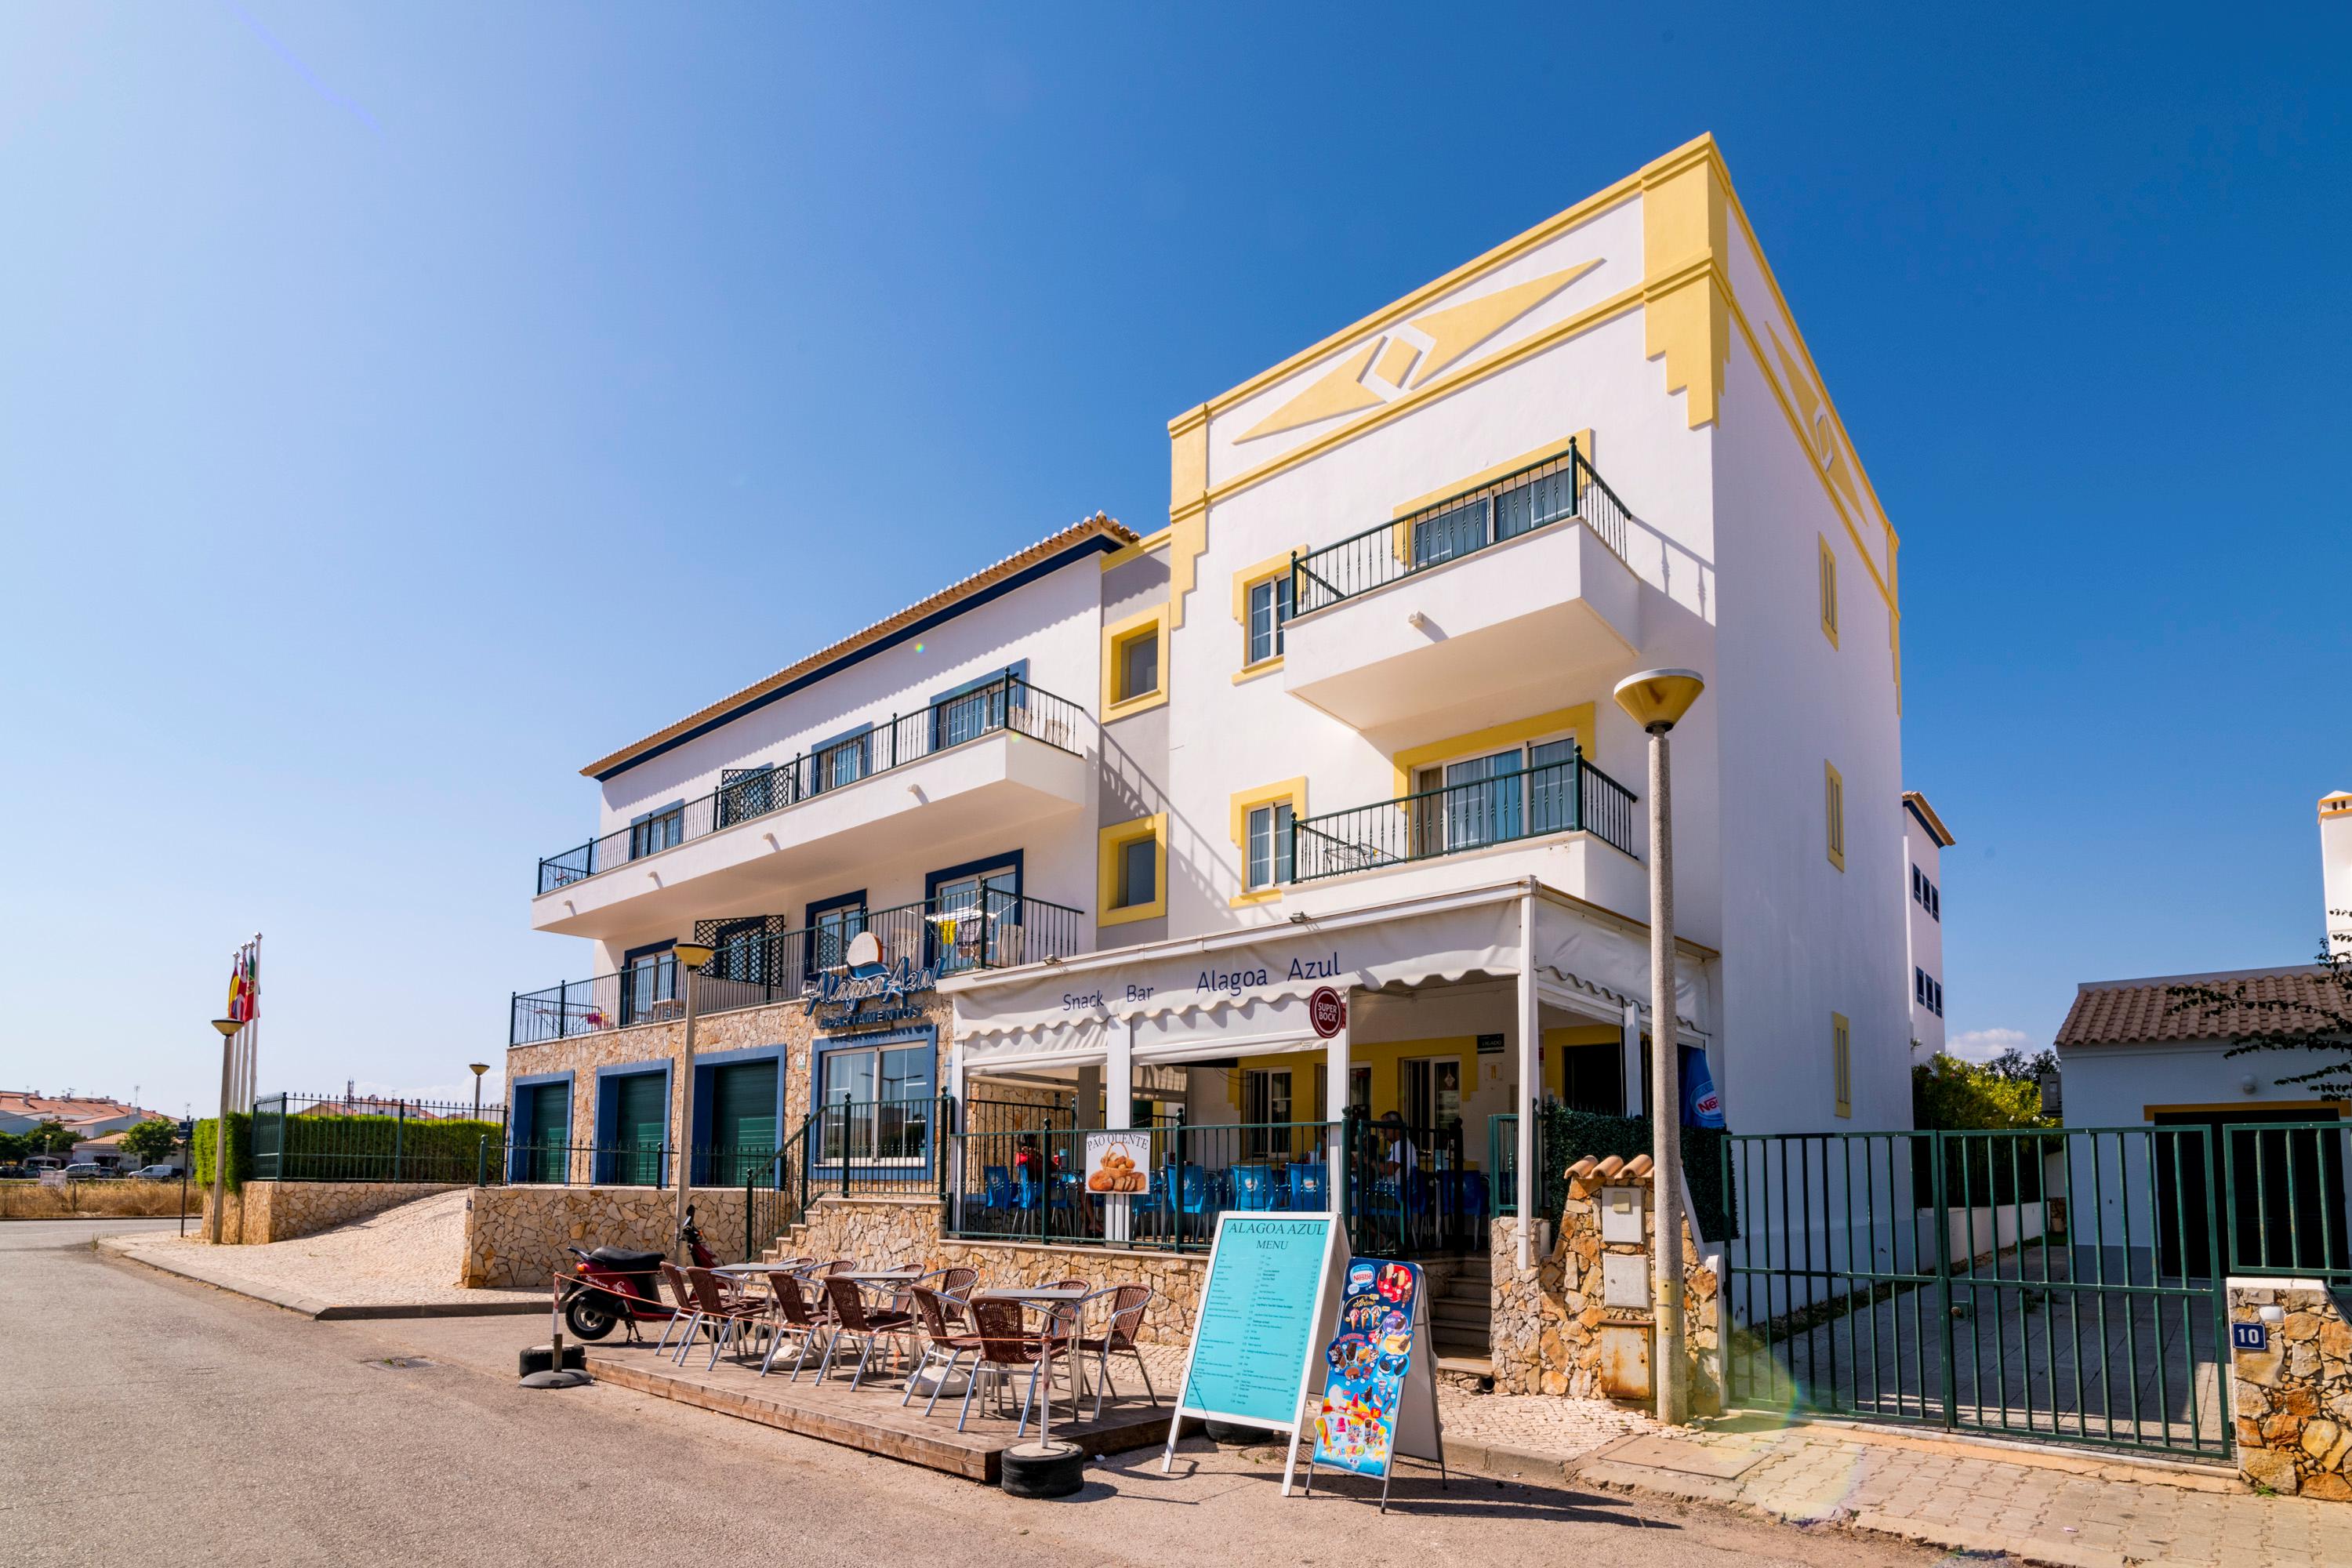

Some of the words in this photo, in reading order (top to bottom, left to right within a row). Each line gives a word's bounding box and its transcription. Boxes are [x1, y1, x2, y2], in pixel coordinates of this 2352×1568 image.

[804, 971, 886, 1016] Alagoa
[882, 956, 945, 1004] Azul
[1063, 989, 1104, 1011] Snack
[1127, 985, 1154, 1003] Bar
[1196, 969, 1268, 996] Alagoa
[1287, 952, 1341, 982] Azul
[1318, 1002, 1338, 1014] SUPER
[820, 1006, 921, 1029] APARTAMENTOS
[1319, 1011, 1337, 1022] BOCK
[1087, 1135, 1105, 1151] PÃO
[1107, 1133, 1149, 1150] QUENTE
[1229, 1222, 1284, 1235] ALAGOA
[1287, 1223, 1325, 1236] AZUL
[1256, 1240, 1289, 1250] MENU
[2239, 1329, 2259, 1344] 10
